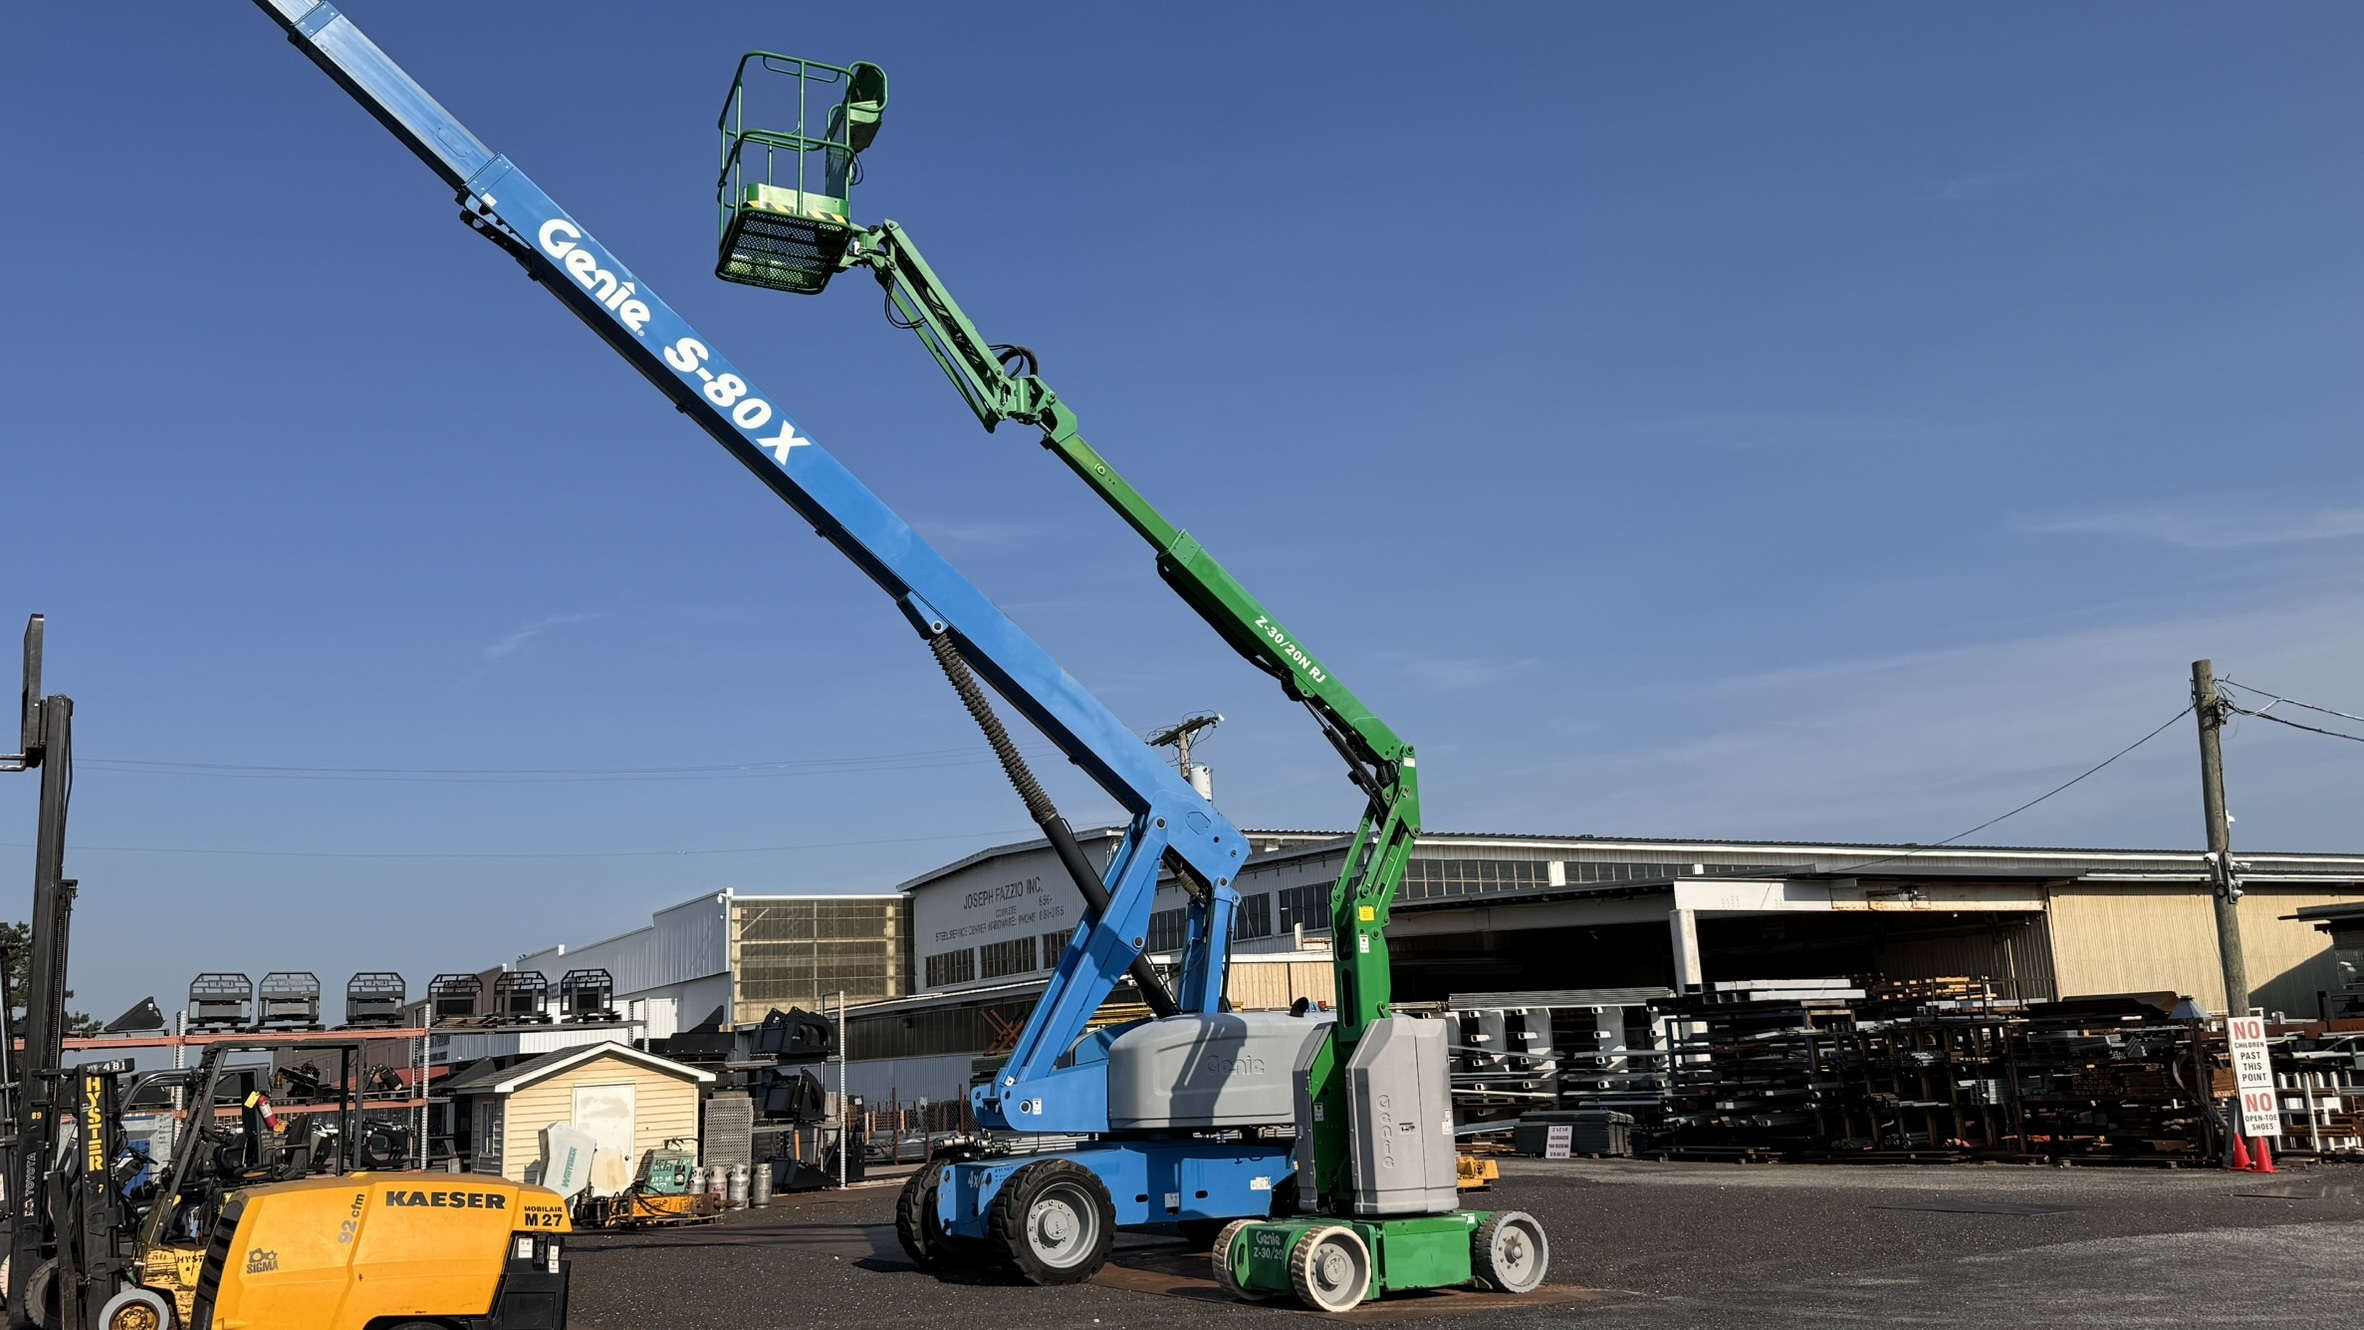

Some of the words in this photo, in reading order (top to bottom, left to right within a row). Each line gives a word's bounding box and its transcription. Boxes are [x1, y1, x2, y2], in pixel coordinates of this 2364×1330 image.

[538, 218, 650, 333] Genie
[663, 337, 772, 429] S-80
[755, 419, 812, 466] X
[1255, 615, 1312, 670] Z-30/20N
[1308, 665, 1327, 684] RJ
[963, 889, 994, 910] JOSEPH
[995, 881, 1024, 902] FAZZIO
[1026, 876, 1043, 895] INC.
[2232, 1020, 2261, 1040] NO
[2233, 1041, 2265, 1049] CHILDREN
[1204, 1054, 1265, 1076] Genie
[2240, 1051, 2261, 1061] PAST
[2242, 1062, 2263, 1071] THIS
[2242, 1072, 2267, 1082] POINT
[2244, 1092, 2273, 1113] NO
[31, 1111, 42, 1120] 89
[86, 1076, 104, 1172] HYSTER
[2244, 1113, 2278, 1123] OPEN-TOE
[1376, 1093, 1395, 1169] Genie
[2251, 1122, 2274, 1131] SHOES
[25, 1151, 37, 1197] TOYOTA
[385, 1190, 506, 1210] KAESER
[524, 1205, 563, 1213] MOBILAIR
[337, 1219, 358, 1244] 92
[350, 1192, 365, 1218] cfm
[525, 1214, 538, 1226] M
[542, 1214, 563, 1226] 27
[1255, 1230, 1281, 1246] Genie
[246, 1260, 279, 1274] SIGMA
